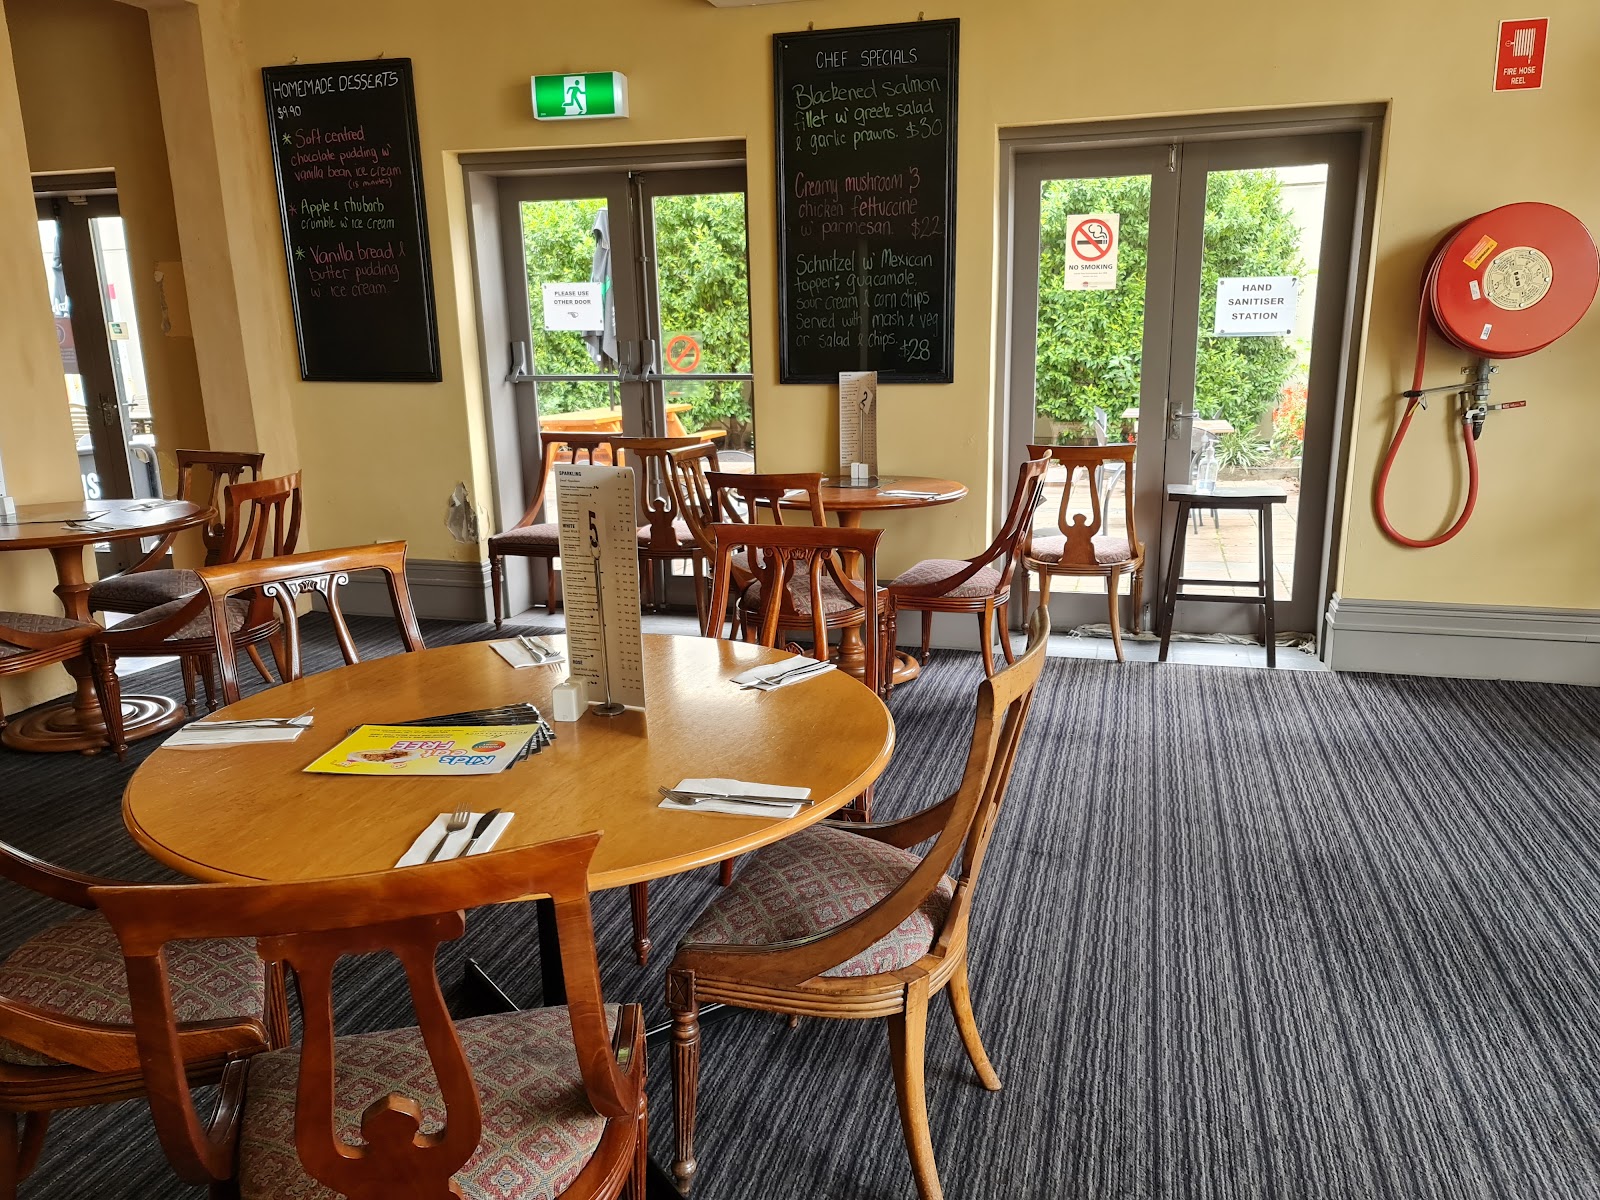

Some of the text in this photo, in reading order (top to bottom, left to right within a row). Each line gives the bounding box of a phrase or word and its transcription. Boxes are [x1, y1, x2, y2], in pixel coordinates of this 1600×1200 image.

[816, 47, 918, 69] CHEF SPECIALS
[1503, 65, 1536, 75] FIRE HOSE
[1510, 76, 1526, 85] REEL
[273, 71, 399, 99] HOMEMADE DESSERTS
[791, 79, 878, 110] Blackened
[277, 105, 302, 120] $9.90
[794, 109, 828, 132] fillet
[854, 102, 893, 126] greek
[895, 98, 934, 117] salad
[295, 125, 366, 149] Soft centred
[810, 130, 847, 155] garlic
[905, 117, 943, 139] $30
[291, 149, 336, 167] chocolate
[340, 145, 379, 166] pudding
[294, 165, 324, 182] vanilla
[370, 166, 402, 176] cream
[795, 172, 839, 203] Creamy
[845, 172, 903, 193] mushroom
[301, 198, 330, 217] Apple
[344, 195, 385, 213] rhubarb
[798, 194, 918, 219] chicken fettuccine
[301, 216, 337, 230] crumble
[367, 217, 395, 229] cream
[911, 215, 943, 240] $22
[309, 242, 354, 265] Vanilla
[356, 241, 395, 261] bread
[796, 249, 855, 276] Schnitzel
[881, 248, 933, 268] Mexican
[309, 261, 400, 283] butter pudding
[330, 286, 347, 297] ice
[1242, 284, 1272, 292] HAND
[824, 295, 859, 310] cream
[873, 294, 897, 309] corn
[900, 289, 930, 312] chips
[1228, 297, 1285, 306] SANITISER
[796, 313, 835, 329] Served
[841, 310, 863, 328] with
[872, 310, 905, 328] mash
[919, 312, 939, 337] veg
[1231, 312, 1278, 320] STATION
[898, 338, 931, 363] $28
[588, 510, 599, 548] 5
[390, 740, 456, 750] FREE
[420, 749, 468, 758] eat
[439, 755, 496, 766] Kids
